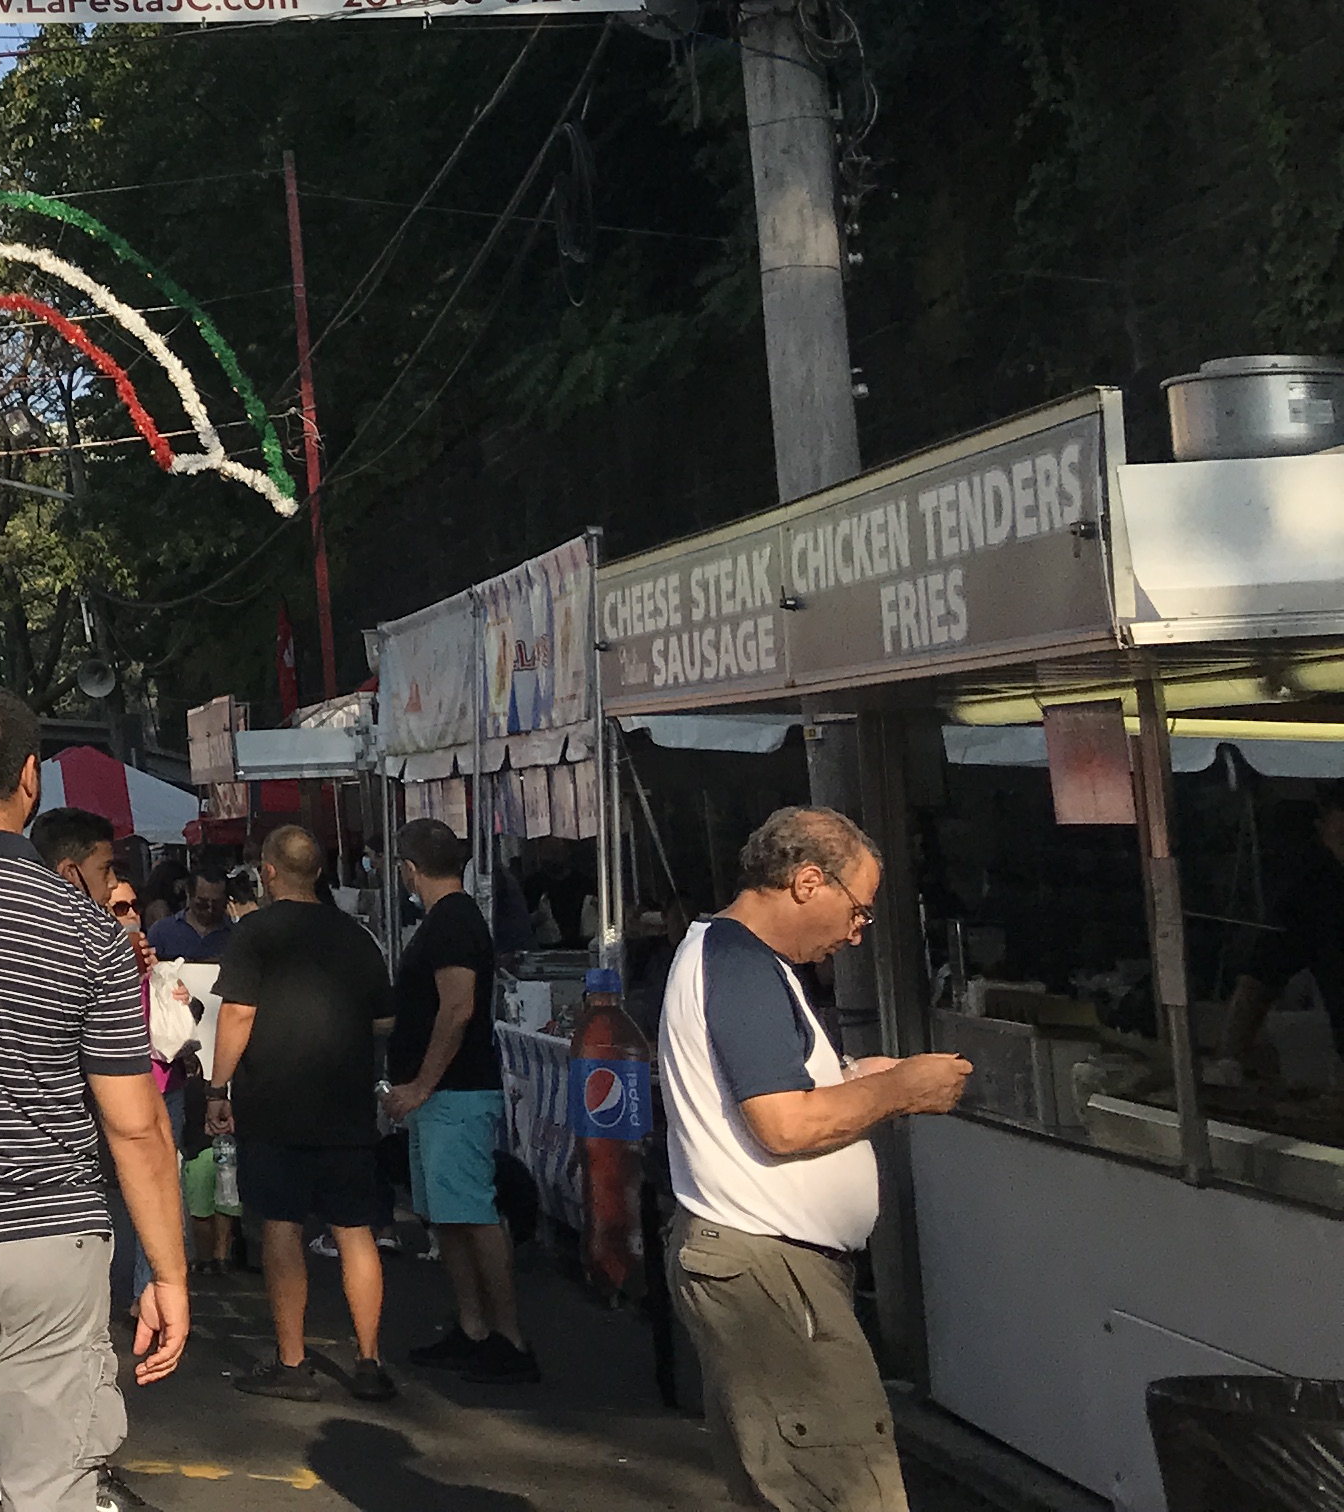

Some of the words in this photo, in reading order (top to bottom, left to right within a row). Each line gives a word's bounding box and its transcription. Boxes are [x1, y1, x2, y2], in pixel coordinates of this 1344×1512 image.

[790, 494, 911, 594] CHICKEN
[918, 443, 1083, 561] TENDERS
[604, 573, 681, 640] CHEESE
[690, 544, 774, 623] STEAK
[880, 569, 968, 654] FRIES
[651, 615, 778, 688] SAUSAGE
[626, 1073, 641, 1127] pepsi
